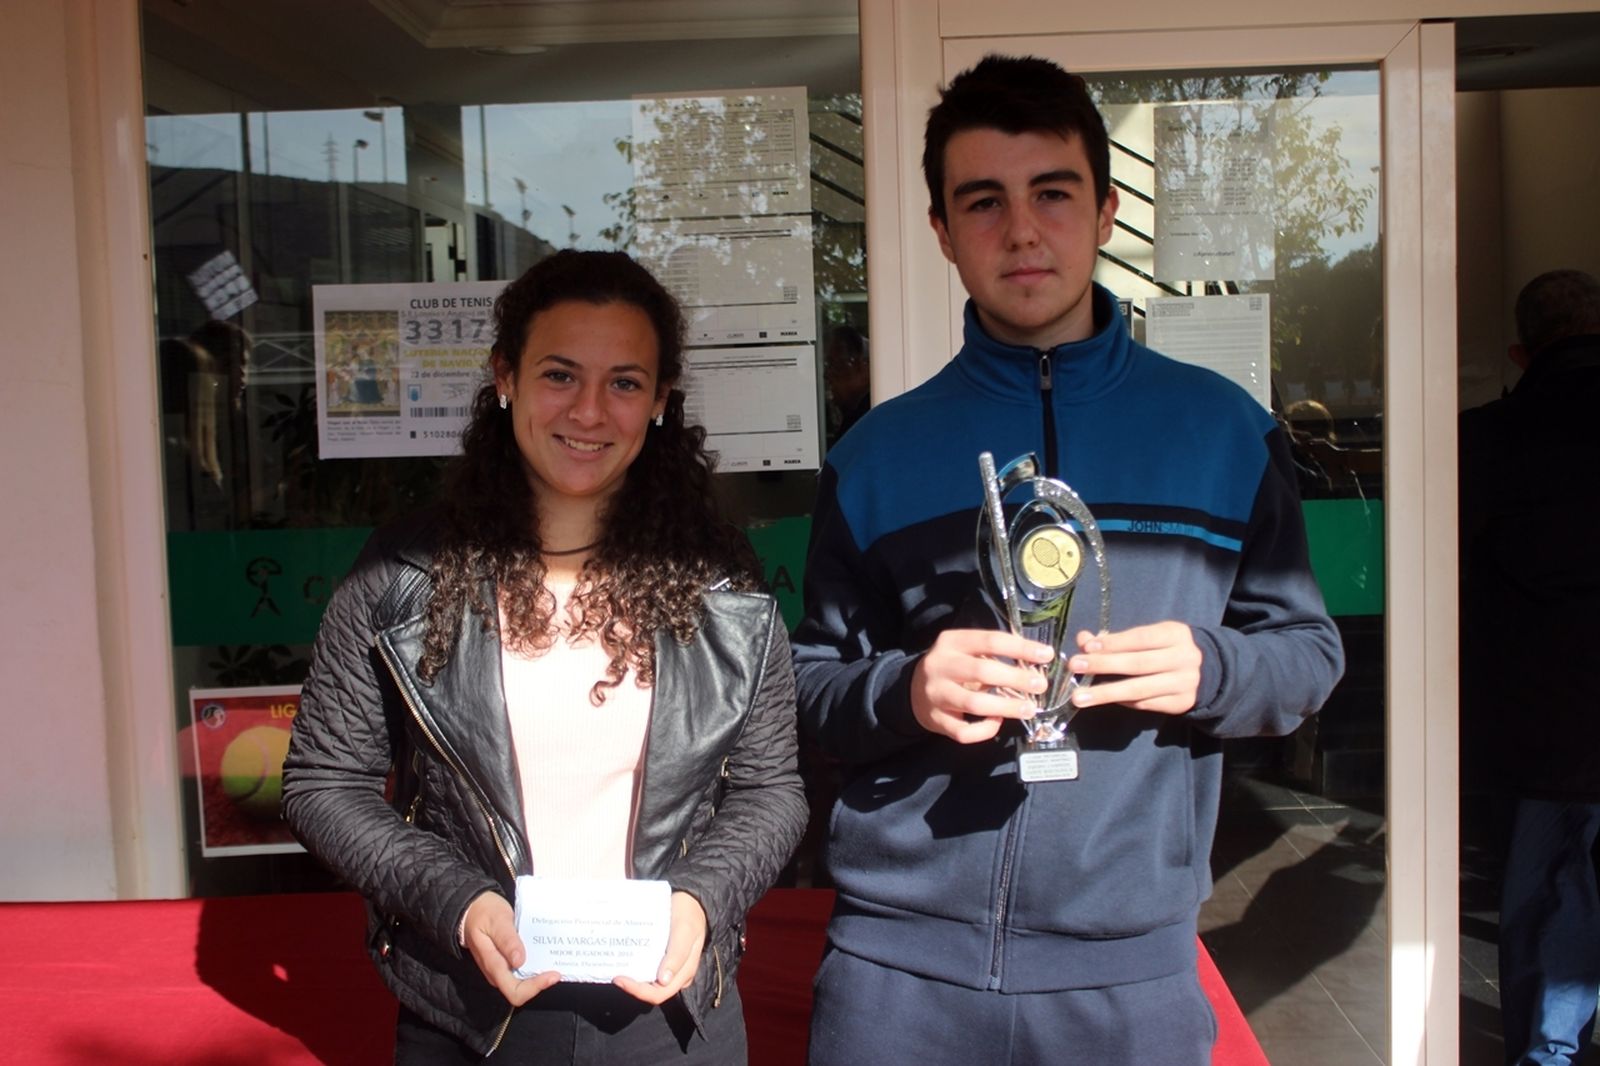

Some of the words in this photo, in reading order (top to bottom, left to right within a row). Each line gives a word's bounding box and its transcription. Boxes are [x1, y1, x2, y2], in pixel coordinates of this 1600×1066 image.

[410, 299, 439, 309] CLUB
[443, 298, 457, 308] DE
[460, 297, 493, 308] TENIS
[433, 370, 470, 378] diciembre
[1128, 520, 1162, 532] JOHN
[270, 703, 298, 719] LIG
[532, 936, 565, 945] SILVIA
[566, 936, 607, 946] VARGAS
[609, 936, 651, 947] JIMÉNEZ
[549, 949, 573, 957] MEJOR
